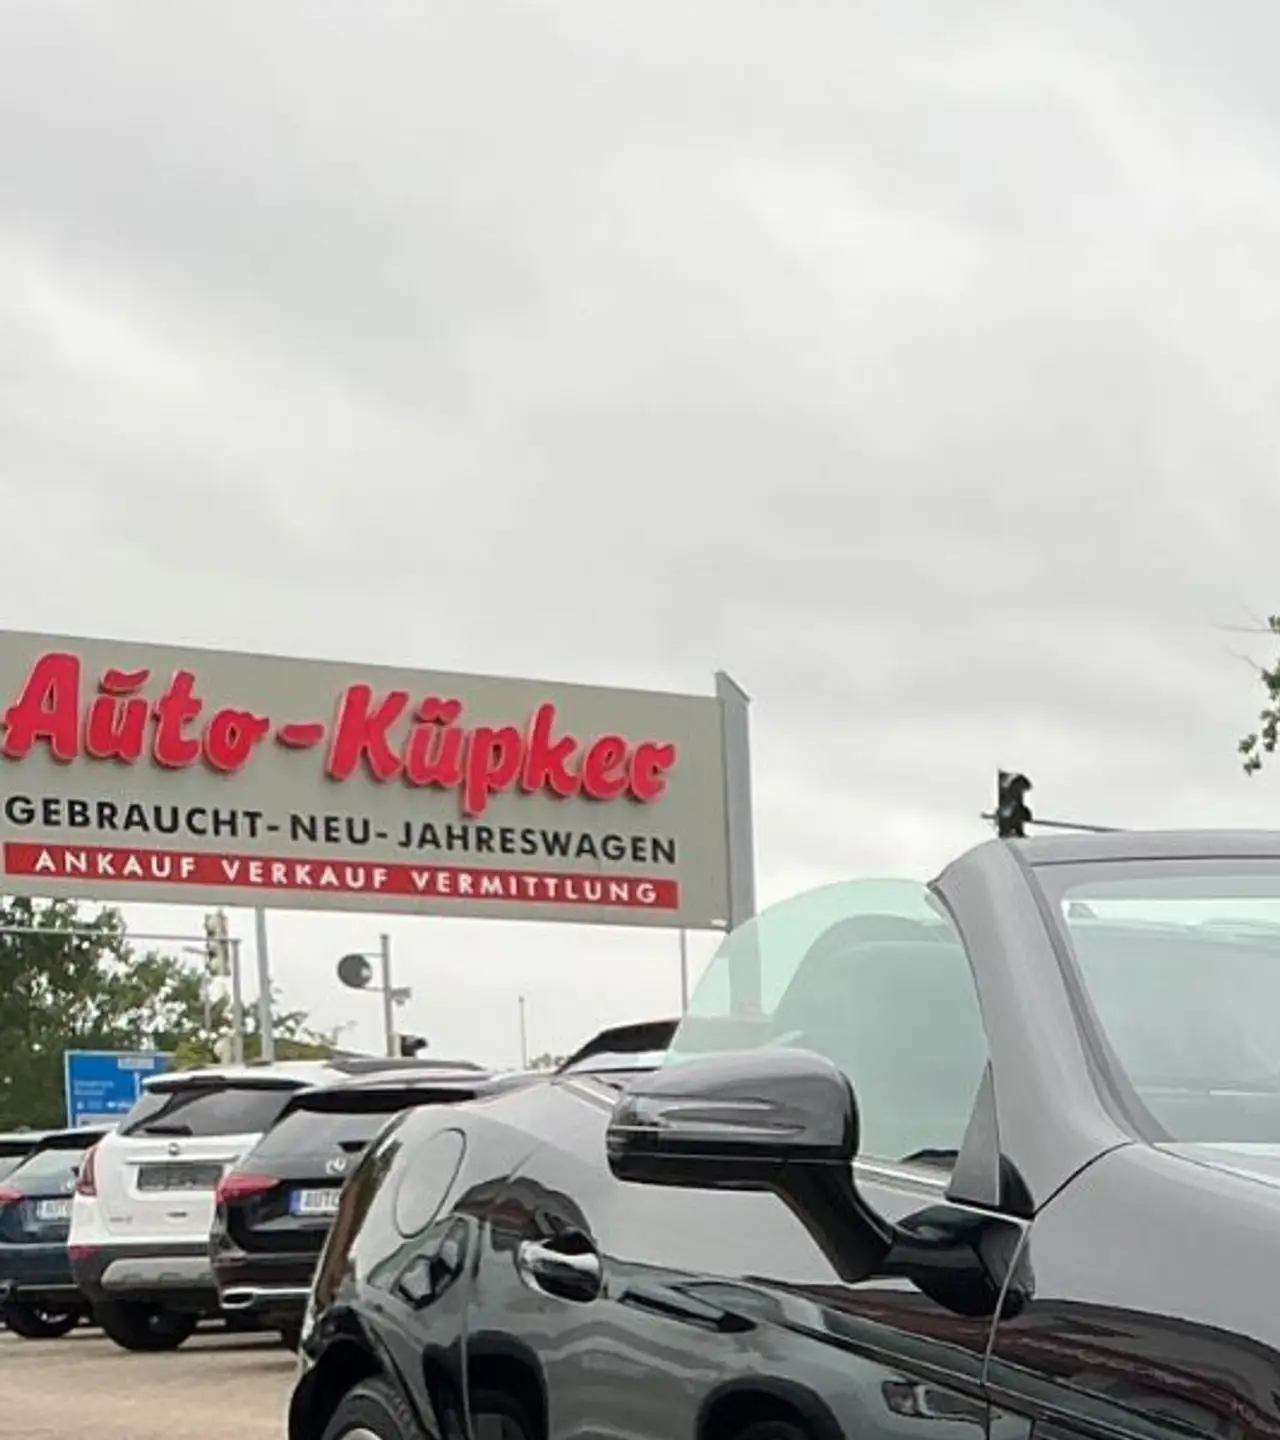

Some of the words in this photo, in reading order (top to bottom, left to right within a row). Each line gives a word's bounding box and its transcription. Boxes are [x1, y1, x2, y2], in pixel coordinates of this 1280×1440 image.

[35, 849, 196, 878] ANKAUF
[220, 859, 389, 889] VERKAUF
[411, 869, 657, 904] VERMITTLUNG
